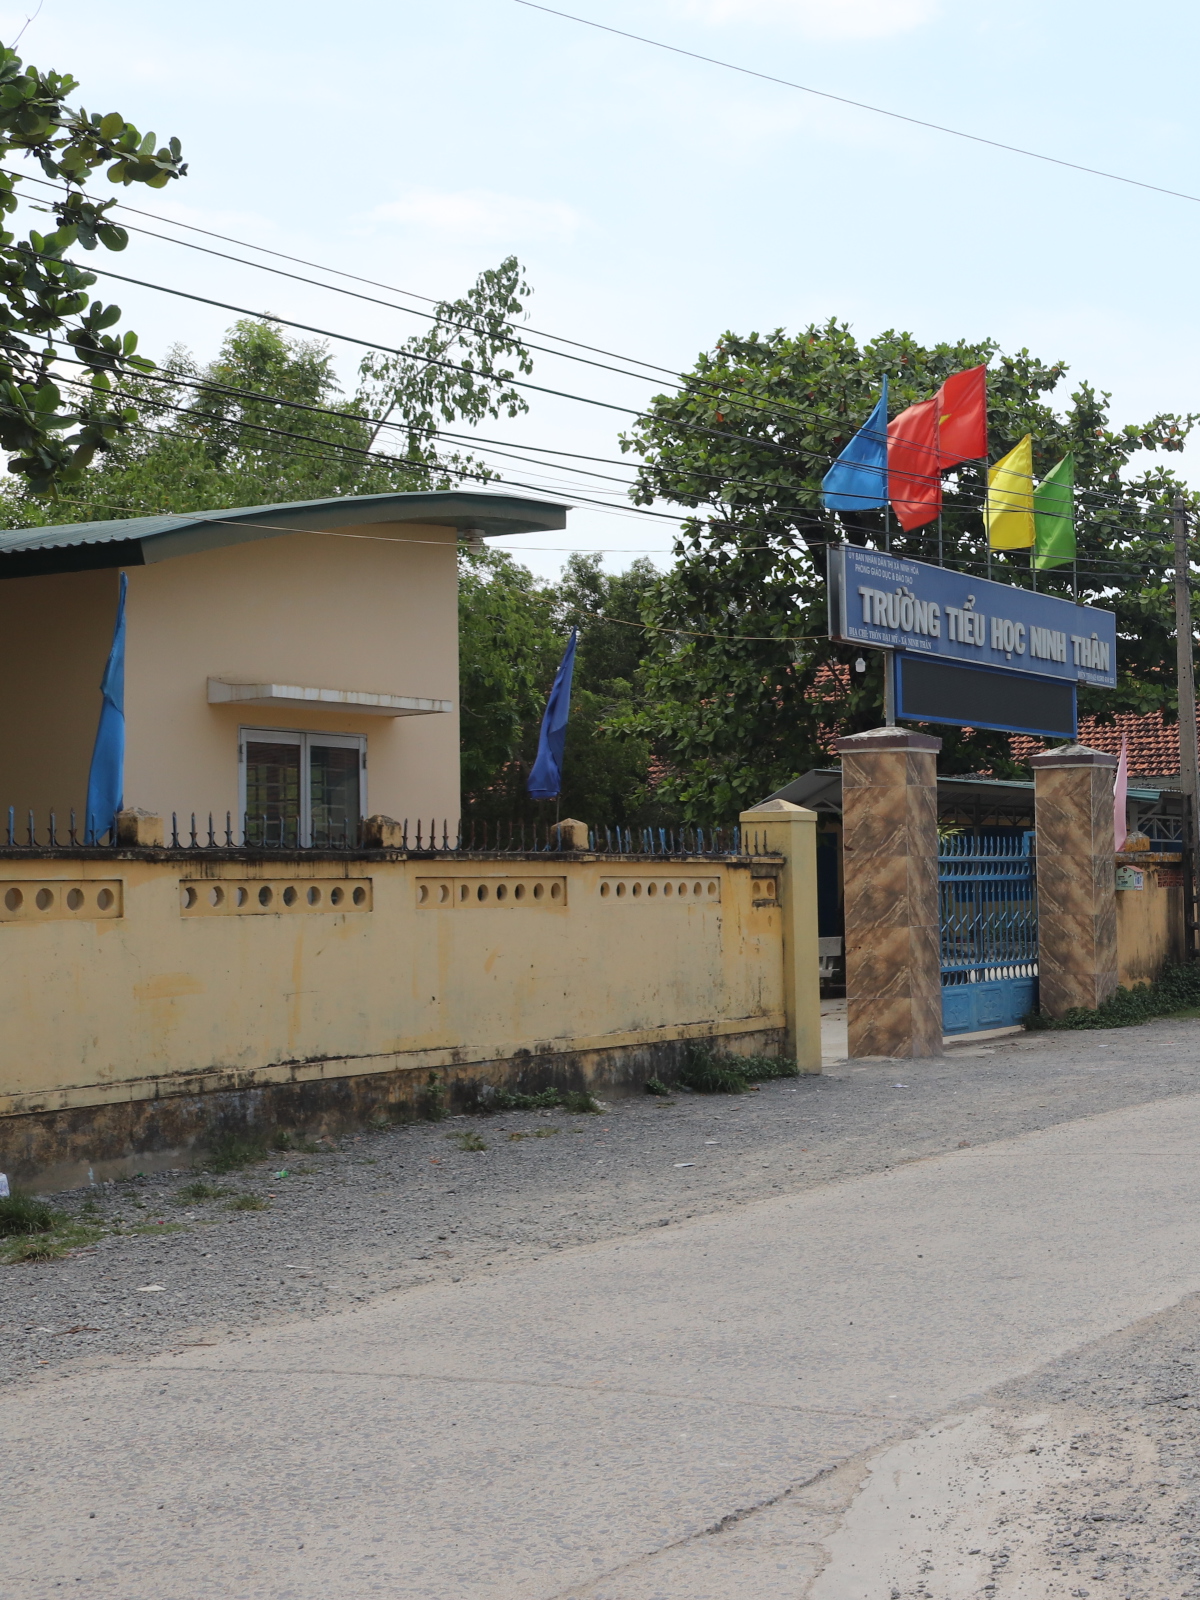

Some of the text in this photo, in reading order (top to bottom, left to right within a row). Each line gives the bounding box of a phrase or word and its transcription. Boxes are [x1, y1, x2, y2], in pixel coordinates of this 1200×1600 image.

[855, 562, 913, 585] PHÒNG GIÁO DỤC & ĐÀO TẠO
[856, 553, 865, 562] BAN
[865, 554, 878, 565] NHÂN
[878, 557, 887, 567] DÂN
[894, 560, 900, 571] XÃ
[900, 563, 910, 573] NINH
[848, 627, 858, 637] ĐỊA
[869, 629, 881, 640] THÔN
[901, 635, 908, 645] XÃ
[908, 637, 919, 648] NINH
[919, 639, 932, 650] THÂN
[858, 586, 1110, 672] TRƯỜNG TIỂU HỌC NINH THÂN
